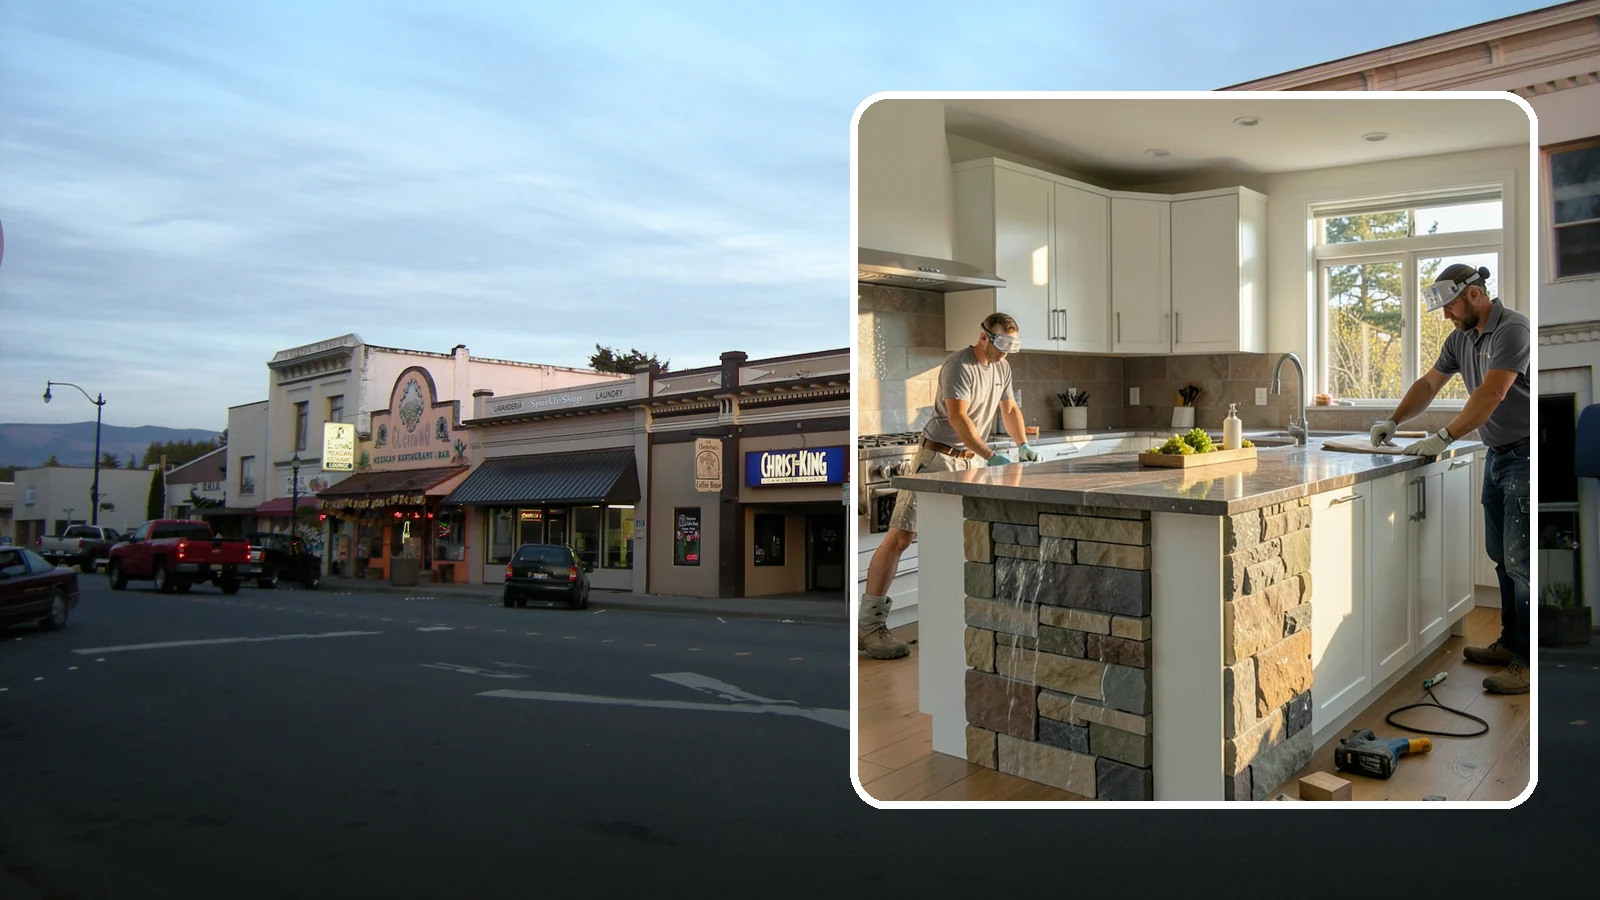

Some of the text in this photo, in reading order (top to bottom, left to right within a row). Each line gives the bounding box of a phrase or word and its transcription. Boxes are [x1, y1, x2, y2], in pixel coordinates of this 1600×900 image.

[596, 390, 623, 400] LAUNDRY
[494, 402, 522, 412] LAVANDERIA
[397, 450, 433, 463] RESTAURANT
[438, 450, 450, 459] BAR
[761, 450, 827, 478] CHRIST KING
